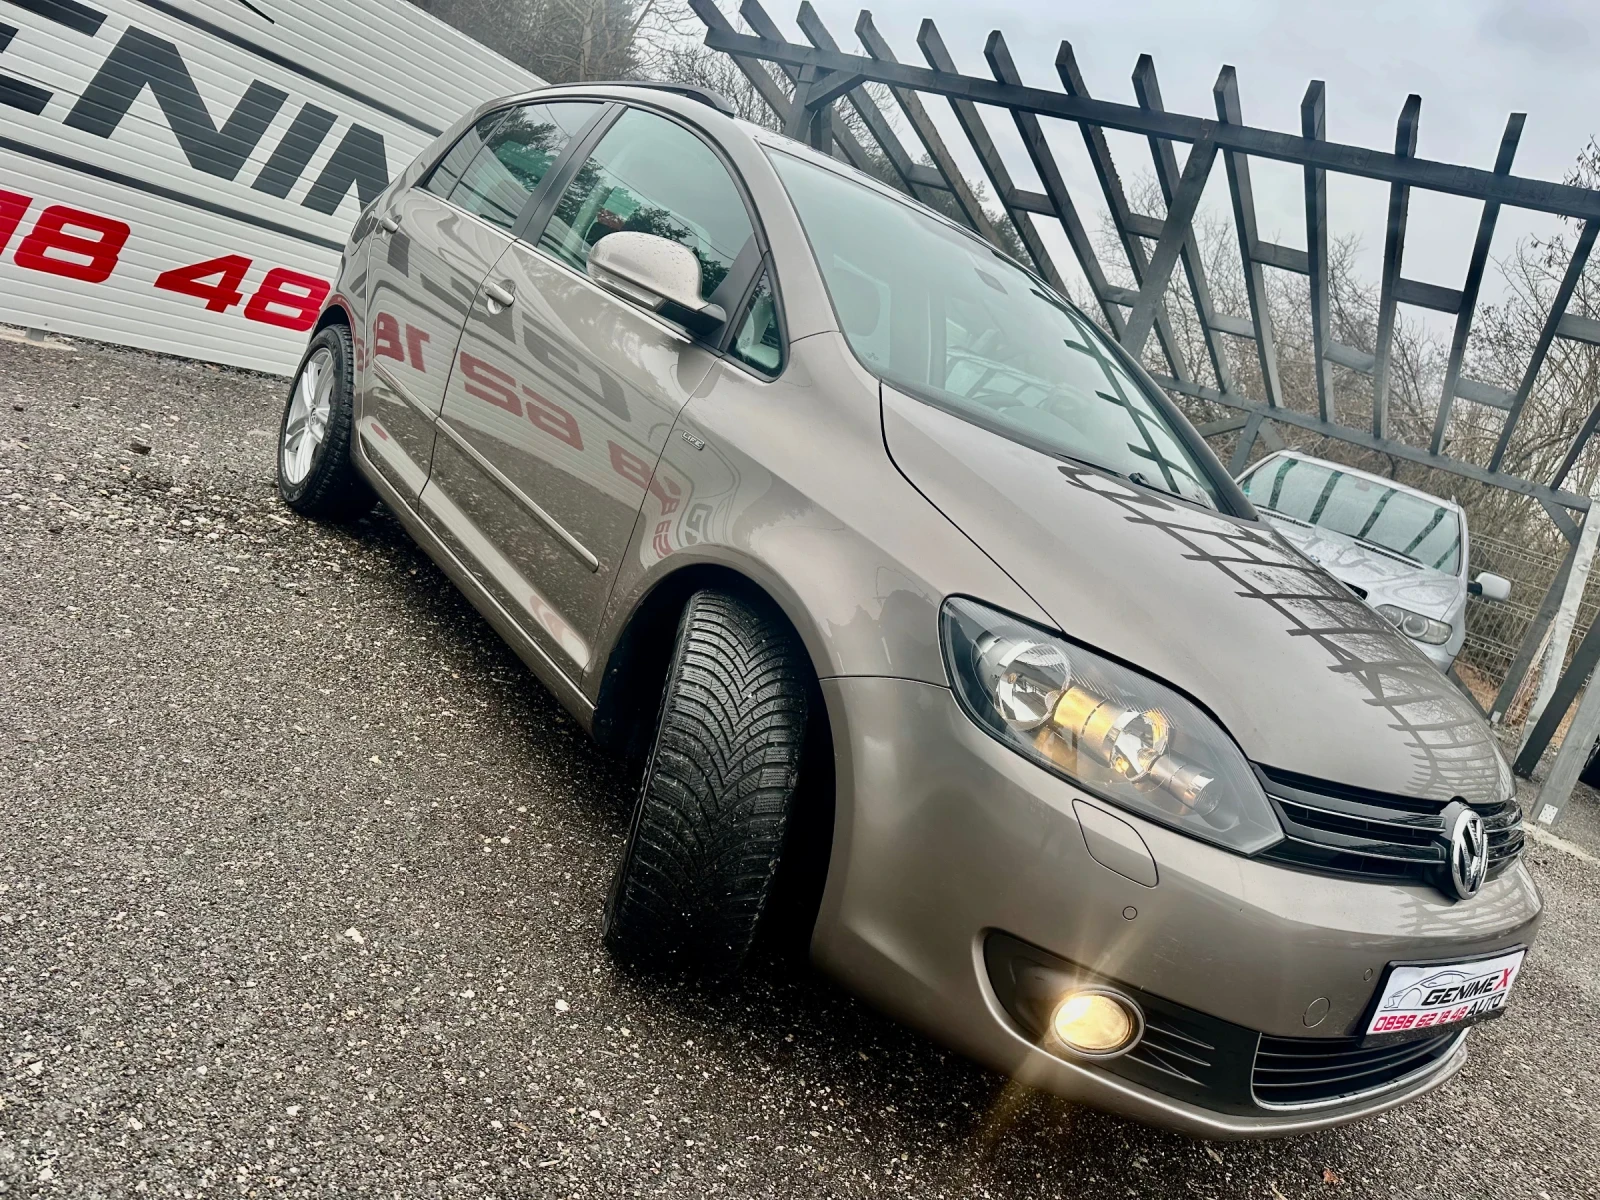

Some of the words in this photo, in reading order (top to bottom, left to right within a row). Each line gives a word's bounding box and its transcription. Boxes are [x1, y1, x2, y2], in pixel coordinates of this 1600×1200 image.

[154, 254, 331, 332] 48
[682, 431, 703, 448] LIFE
[1421, 966, 1515, 1006] GENIMEX
[1464, 993, 1505, 1019] AUTO
[1373, 1014, 1417, 1032] 0898
[1415, 1012, 1438, 1028] 62
